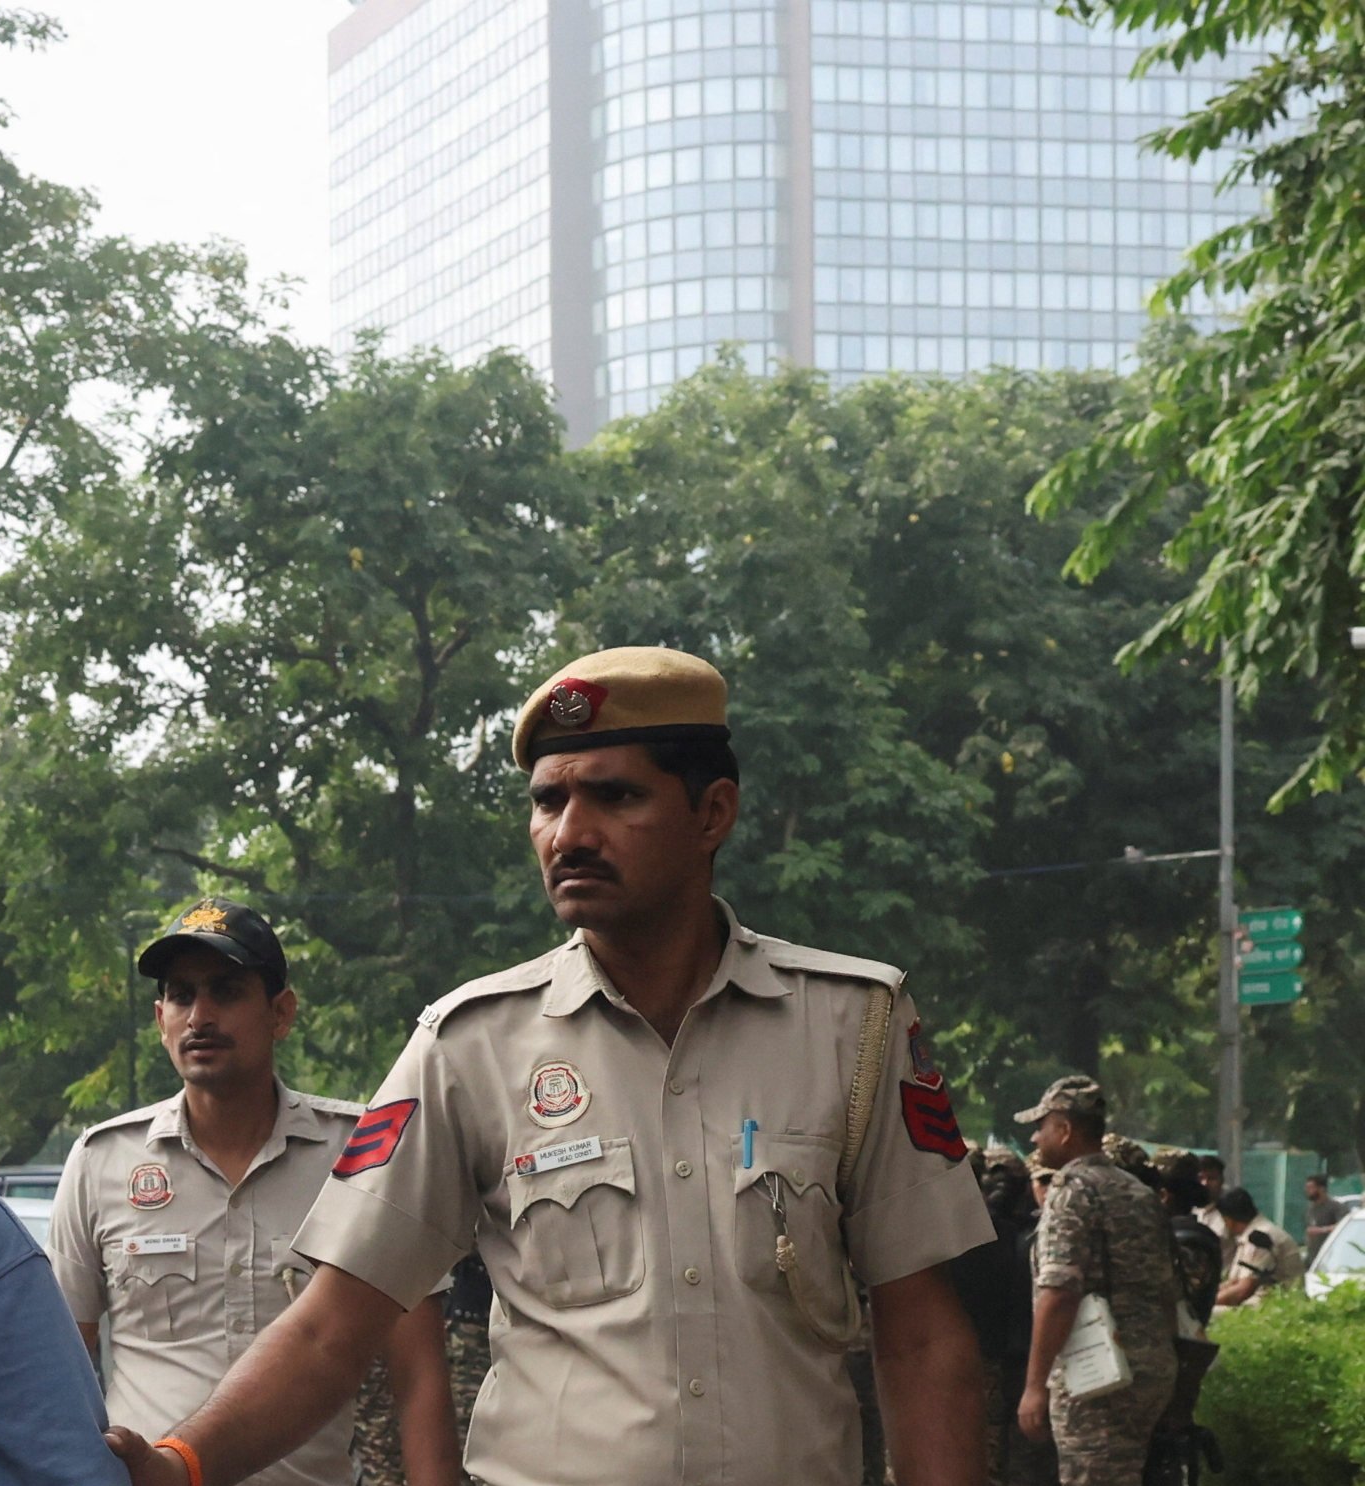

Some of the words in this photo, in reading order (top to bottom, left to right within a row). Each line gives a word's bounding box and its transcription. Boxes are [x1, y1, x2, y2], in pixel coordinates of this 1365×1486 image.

[540, 1147, 566, 1160] MUKESH
[569, 1141, 591, 1152] KUMAR
[558, 1154, 573, 1163] HEAD
